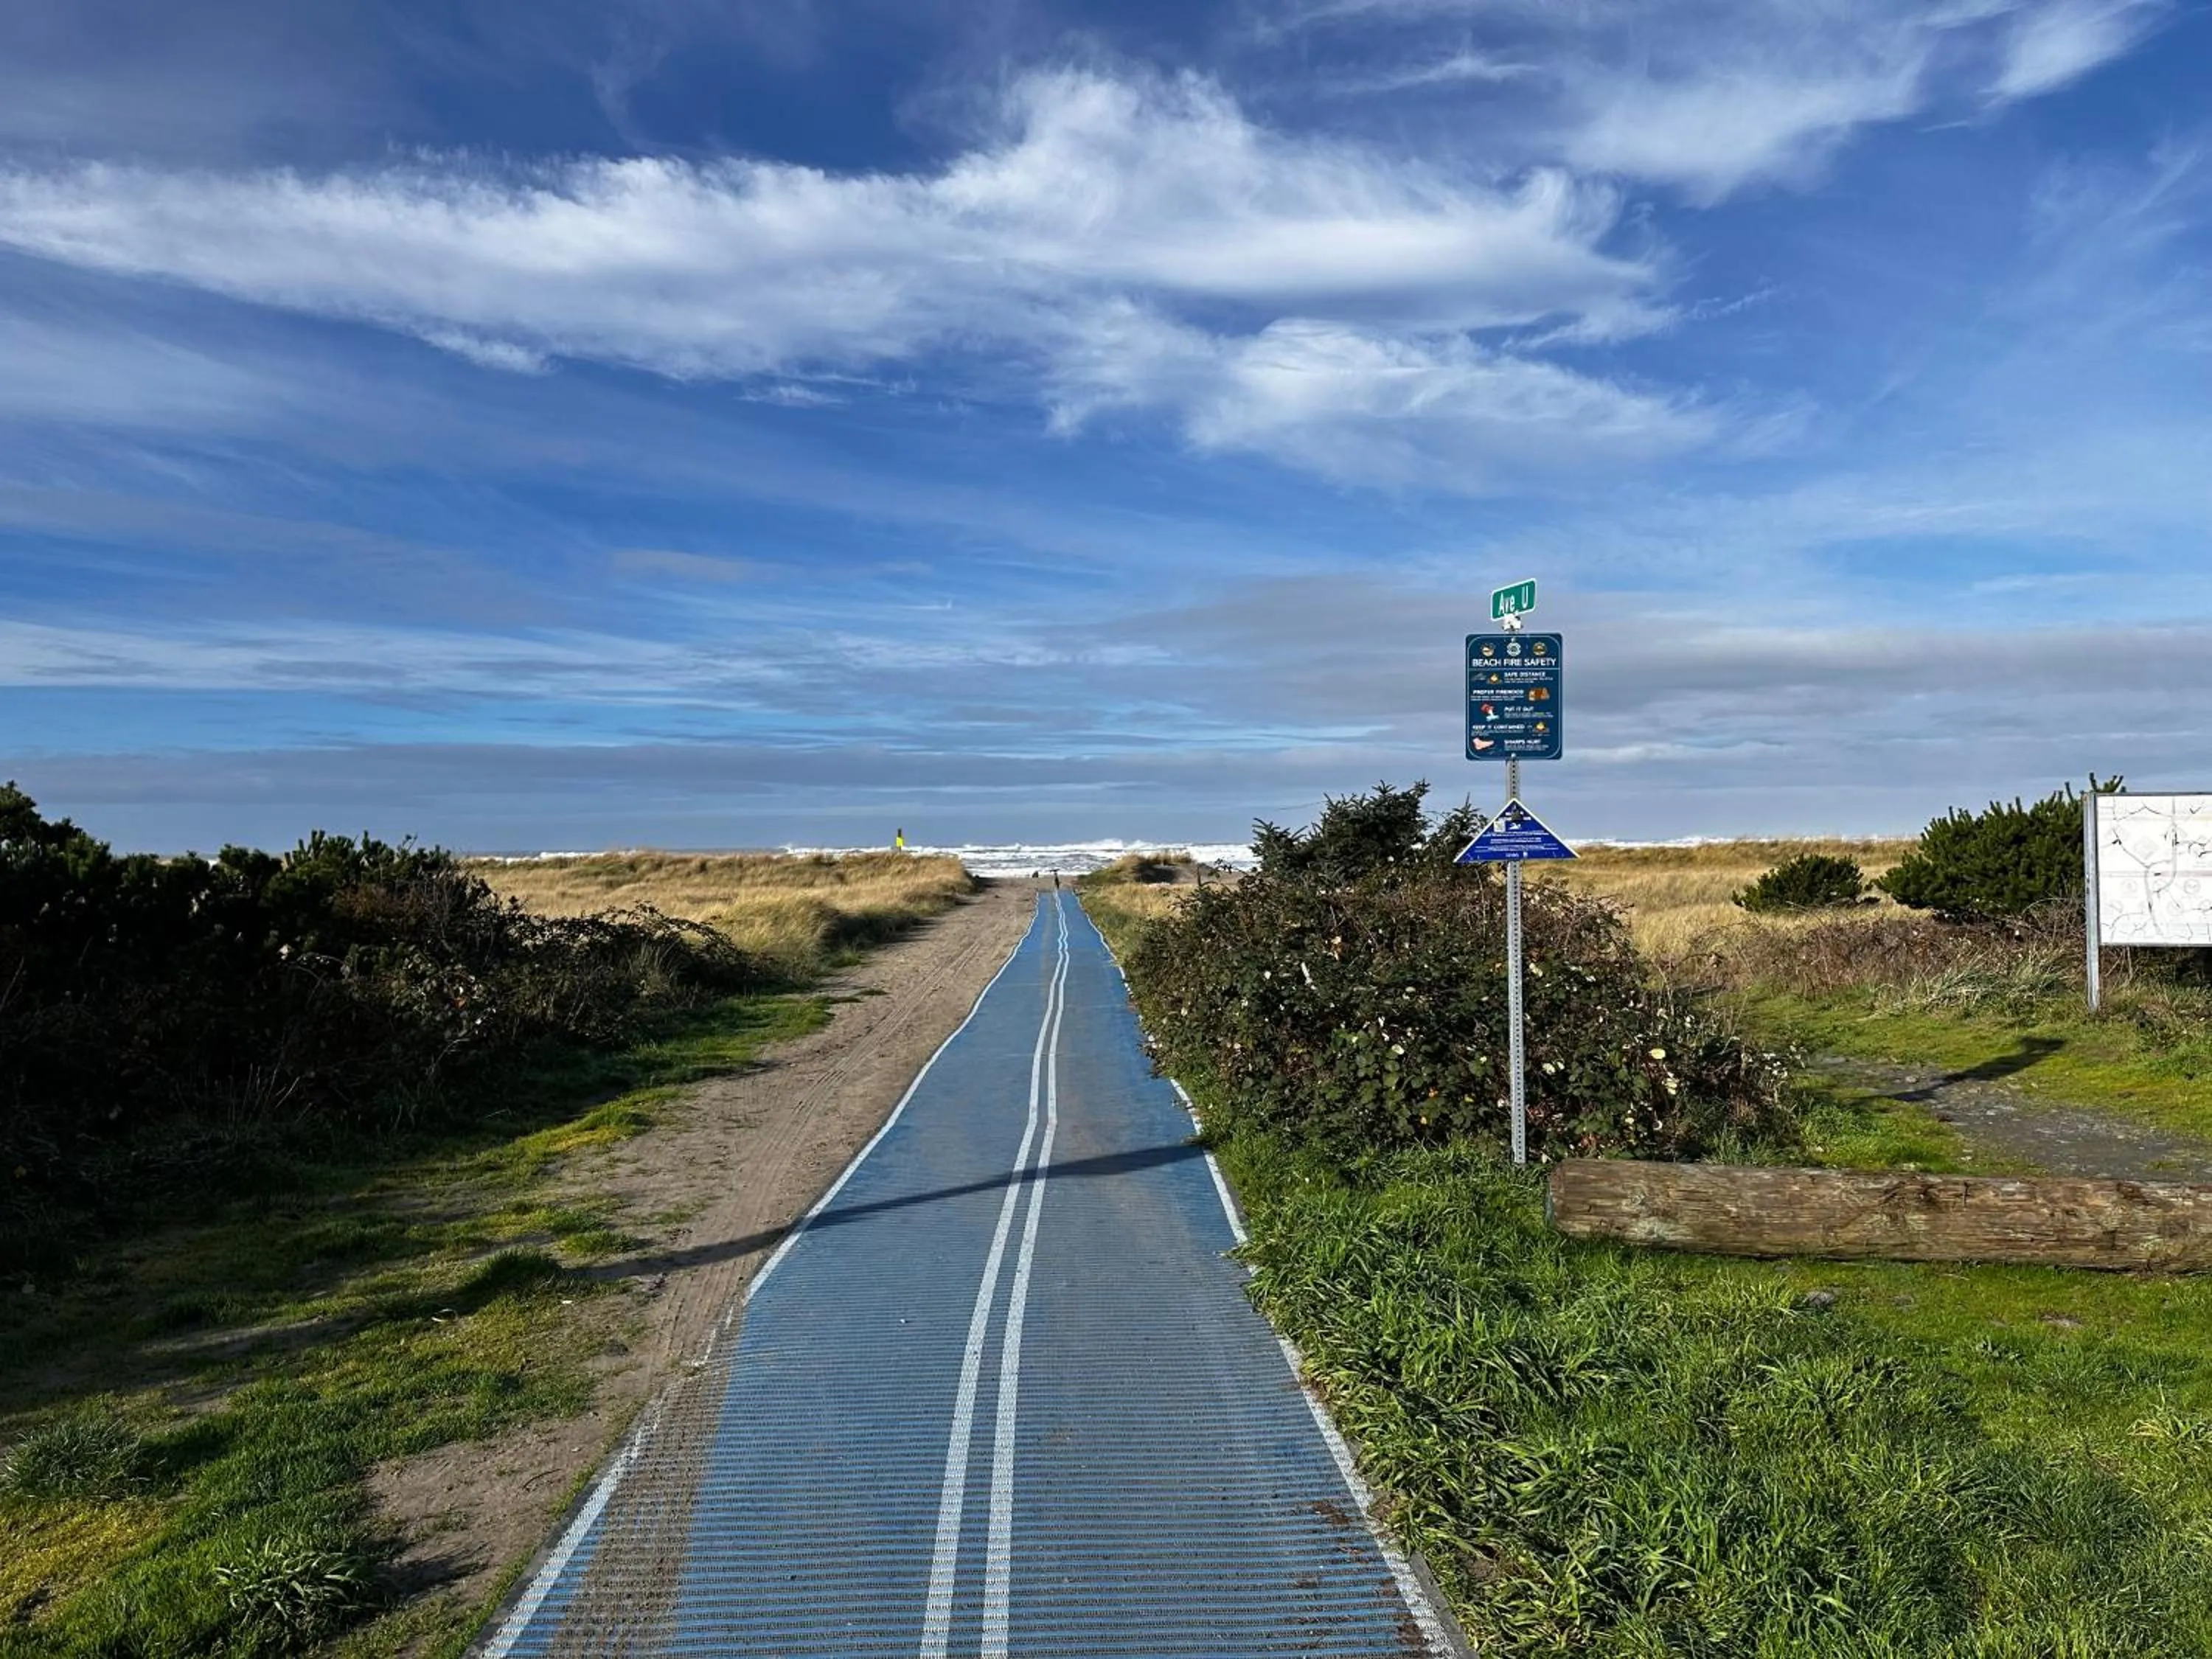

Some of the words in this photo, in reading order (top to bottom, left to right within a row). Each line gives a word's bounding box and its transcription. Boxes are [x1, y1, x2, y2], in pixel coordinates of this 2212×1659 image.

[1498, 592, 1515, 615] Ave
[1521, 585, 1528, 608] U
[1472, 658, 1501, 667] BEACH
[1503, 658, 1523, 667] FIRE
[1524, 658, 1557, 666] SAFETY
